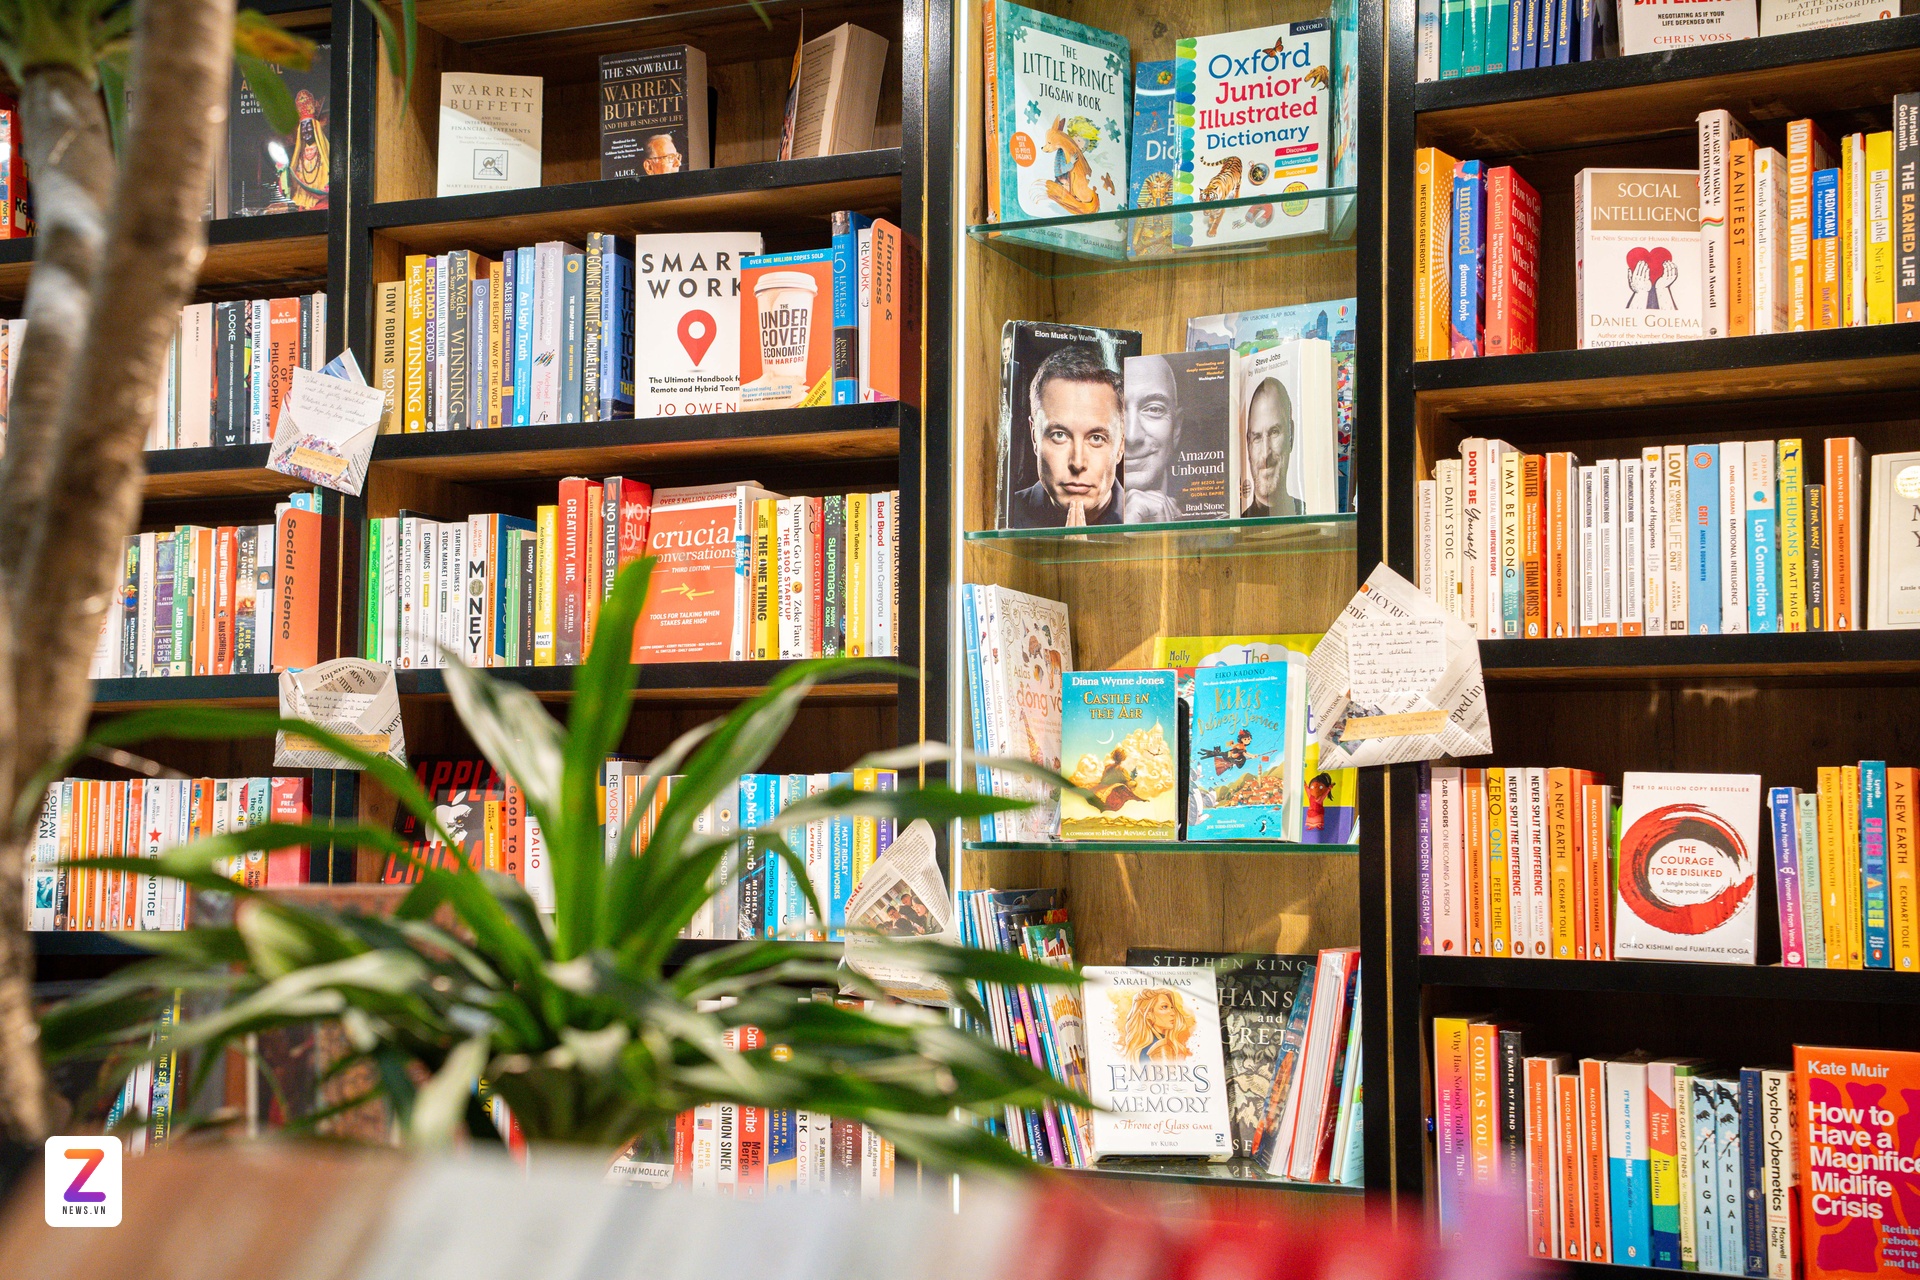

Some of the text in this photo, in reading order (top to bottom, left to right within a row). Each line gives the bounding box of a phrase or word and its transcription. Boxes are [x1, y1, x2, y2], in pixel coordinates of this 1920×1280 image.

[1296, 22, 1323, 32] OXFORD
[1654, 33, 1732, 44] CHRIS VOSS
[1060, 44, 1078, 61] THE
[1208, 42, 1311, 80] Oxford
[602, 60, 682, 80] THE SNOWBALL
[1023, 52, 1116, 95] LITTLE PRINCE
[451, 84, 534, 99] WARREN
[604, 77, 683, 103] WARREN
[1039, 83, 1101, 112] JIGSAW BOOK
[1215, 76, 1303, 104] Junior
[450, 99, 534, 113] BUFFETT
[604, 95, 683, 121] BUFFETT
[1199, 96, 1318, 130] Illustrated
[1207, 126, 1310, 150] Dictionary
[1899, 104, 1908, 152] Goldsmith
[1910, 106, 1919, 147] Marshall
[1617, 183, 1681, 199] SOCIAL
[1733, 155, 1745, 246] MANIFEST
[1789, 124, 1808, 262] HOW TO DO THE WORK
[1459, 186, 1475, 256] untamed
[1902, 162, 1915, 287] THE EARNED LIFE
[774, 256, 792, 264] MILLION
[793, 254, 810, 262] COPIES
[860, 241, 870, 292] REWORK
[875, 228, 884, 305] Business
[647, 277, 741, 299] WORK
[886, 233, 894, 321] Finance &
[411, 264, 422, 320] Jack Welch
[228, 308, 236, 342] LOCKE
[384, 286, 396, 364] TONY ROBBINS
[426, 266, 436, 362] RICH DAD POOR DAD
[761, 308, 808, 329] UNDER
[762, 325, 807, 347] COVER
[1050, 332, 1068, 340] Musk
[764, 345, 806, 358] ECONOMIST
[271, 342, 279, 410] PHILOSOPHY
[280, 368, 288, 382] OF
[408, 326, 422, 413] WINNING
[649, 374, 733, 384] The Ultimate Handbook
[656, 402, 737, 416] JO OWEN
[1177, 449, 1225, 462] Amazon
[1171, 462, 1225, 477] Unbound
[1505, 469, 1515, 497] MAY
[1524, 461, 1538, 497] CHATTER
[1668, 452, 1681, 488] LOVE
[877, 501, 885, 546] Bad Blood
[1444, 487, 1454, 560] DAILY STOIC
[1505, 503, 1515, 518] BE
[1698, 505, 1709, 526] GRIT
[423, 532, 431, 570] ECONOMICS
[565, 498, 577, 585] CREATIVITY, INC.
[759, 535, 768, 556] THE
[1505, 524, 1516, 579] WRONG
[1786, 467, 1799, 617] THE HUMANS MATT HAIG
[282, 518, 296, 640] Social Science
[825, 537, 836, 604] supremacy
[1754, 519, 1768, 617] Lost Connections
[758, 587, 767, 621] THING
[175, 634, 183, 661] DIAMOND
[1072, 675, 1165, 688] Diana Wynne Jones
[1215, 668, 1265, 679] EIKO KADONO
[1083, 691, 1134, 706] CASTLE
[609, 774, 618, 824] REWORK
[1488, 776, 1502, 817] ZERO
[531, 827, 540, 869] DALIO
[1489, 829, 1503, 862] ONE
[1678, 845, 1696, 853] THE
[1651, 867, 1723, 877] TO BE DISLIKED
[1660, 855, 1714, 866] COURAGE
[767, 859, 775, 918] Charles Duhigg
[1662, 888, 1683, 896] change
[1152, 955, 1243, 970] STEPHEN
[1113, 976, 1192, 987] SARAH J. MAAS
[1257, 1012, 1284, 1024] and
[1106, 1064, 1211, 1093] EMBERS
[1808, 1060, 1889, 1078] Kate Muir
[1149, 1082, 1170, 1095] OF
[1474, 1036, 1488, 1147] COME AS YOU
[1110, 1095, 1210, 1114] MEMORY
[1808, 1101, 1895, 1127] How to
[721, 1106, 732, 1171] SIMON SINEK
[1766, 1077, 1782, 1211] Psycho-Cybernetics
[1808, 1123, 1893, 1149] Have a
[613, 1166, 669, 1177] ETHAN MOLLICK
[1811, 1171, 1892, 1198] Midlife
[1811, 1194, 1884, 1219] Crisis
